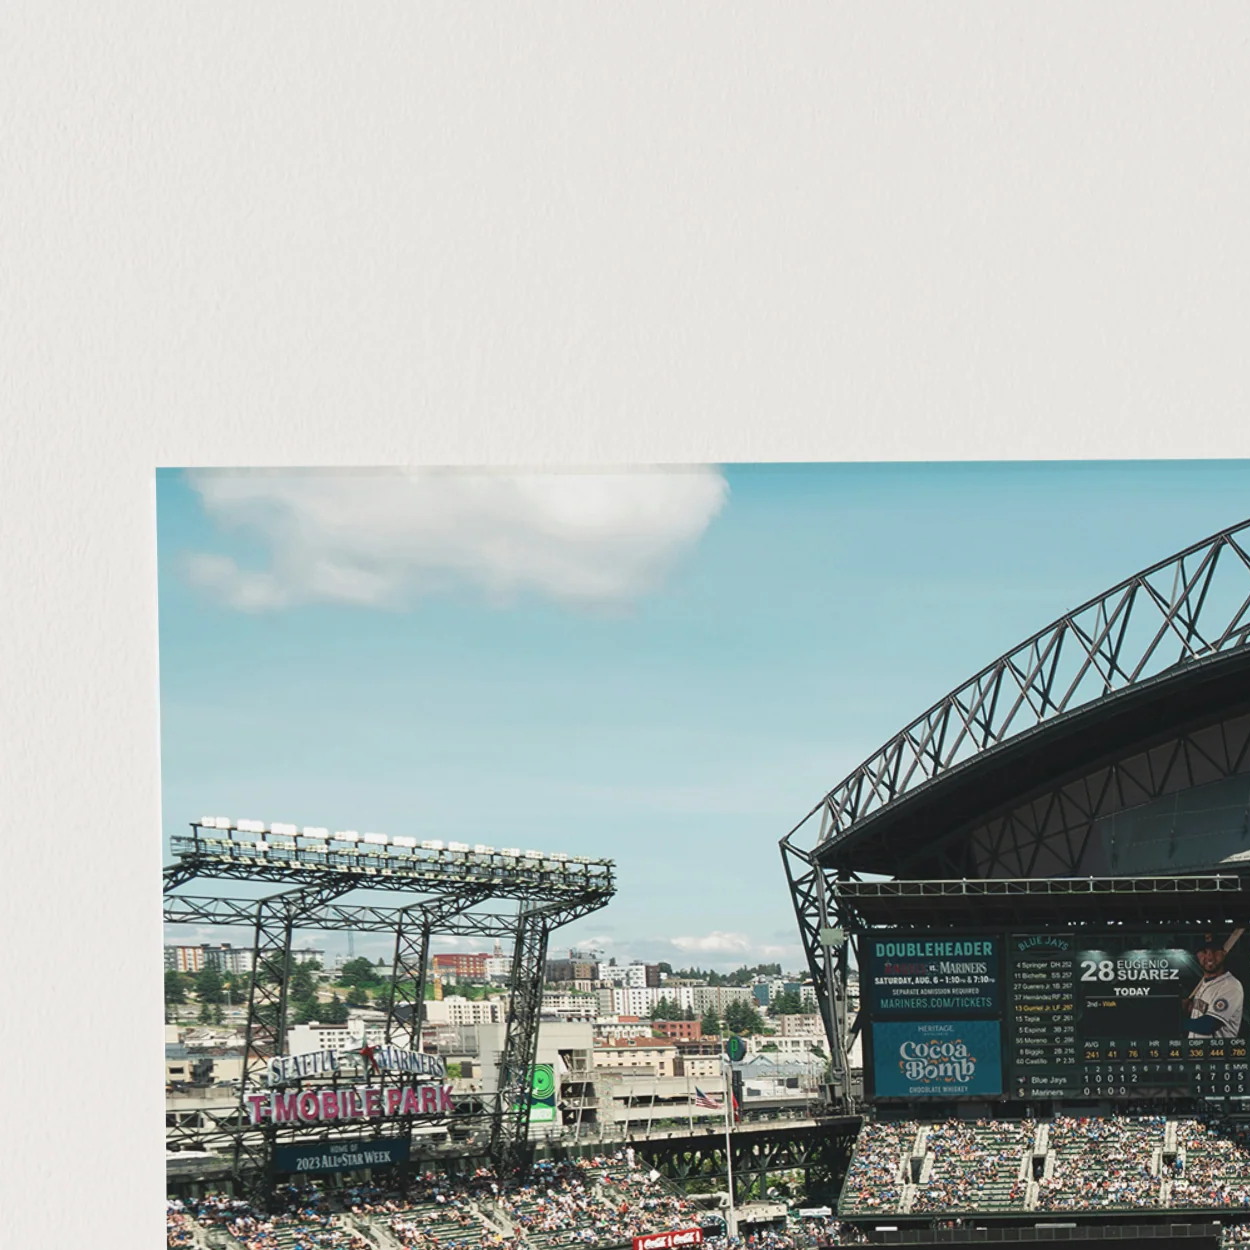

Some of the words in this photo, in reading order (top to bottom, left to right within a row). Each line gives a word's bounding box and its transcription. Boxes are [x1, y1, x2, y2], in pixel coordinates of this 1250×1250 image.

[876, 942, 993, 958] DOUBLEHEADER
[1018, 936, 1043, 951] BLUE
[1045, 936, 1069, 951] JAYS
[940, 960, 988, 974] MARINERS
[1080, 960, 1115, 982] 28
[1117, 960, 1169, 970] EUGENIO
[875, 976, 914, 985] SATURDAY,
[915, 976, 932, 984] AUG.
[1114, 987, 1151, 996] TODAY
[880, 997, 993, 1009] MARINERS.COM/TICKETS
[918, 1024, 954, 1033] HERITAGE
[899, 1040, 968, 1064] Cocoa
[1107, 1050, 1117, 1058] 41
[267, 1050, 341, 1085] SEATTLE
[378, 1045, 447, 1081] MARINERS
[905, 1059, 976, 1083] Bomb
[1031, 1076, 1048, 1084] Blue
[1050, 1076, 1068, 1086] Jays
[1095, 1075, 1102, 1083] 0
[1107, 1075, 1114, 1083] 0
[1132, 1074, 1138, 1082] 2
[1195, 1073, 1201, 1081] 4
[1210, 1073, 1216, 1081] 7
[1224, 1073, 1230, 1081] 0
[1237, 1073, 1244, 1081] 5
[1083, 1087, 1091, 1096] 0
[1107, 1087, 1114, 1095] 0
[1119, 1087, 1126, 1095] 0
[1224, 1085, 1231, 1093] 0
[1238, 1085, 1244, 1093] 5
[246, 1088, 381, 1124] T-MOBILE
[386, 1085, 456, 1115] PARK
[351, 1144, 358, 1152] OF
[296, 1157, 322, 1171] 2023
[363, 1151, 392, 1165] WEEK
